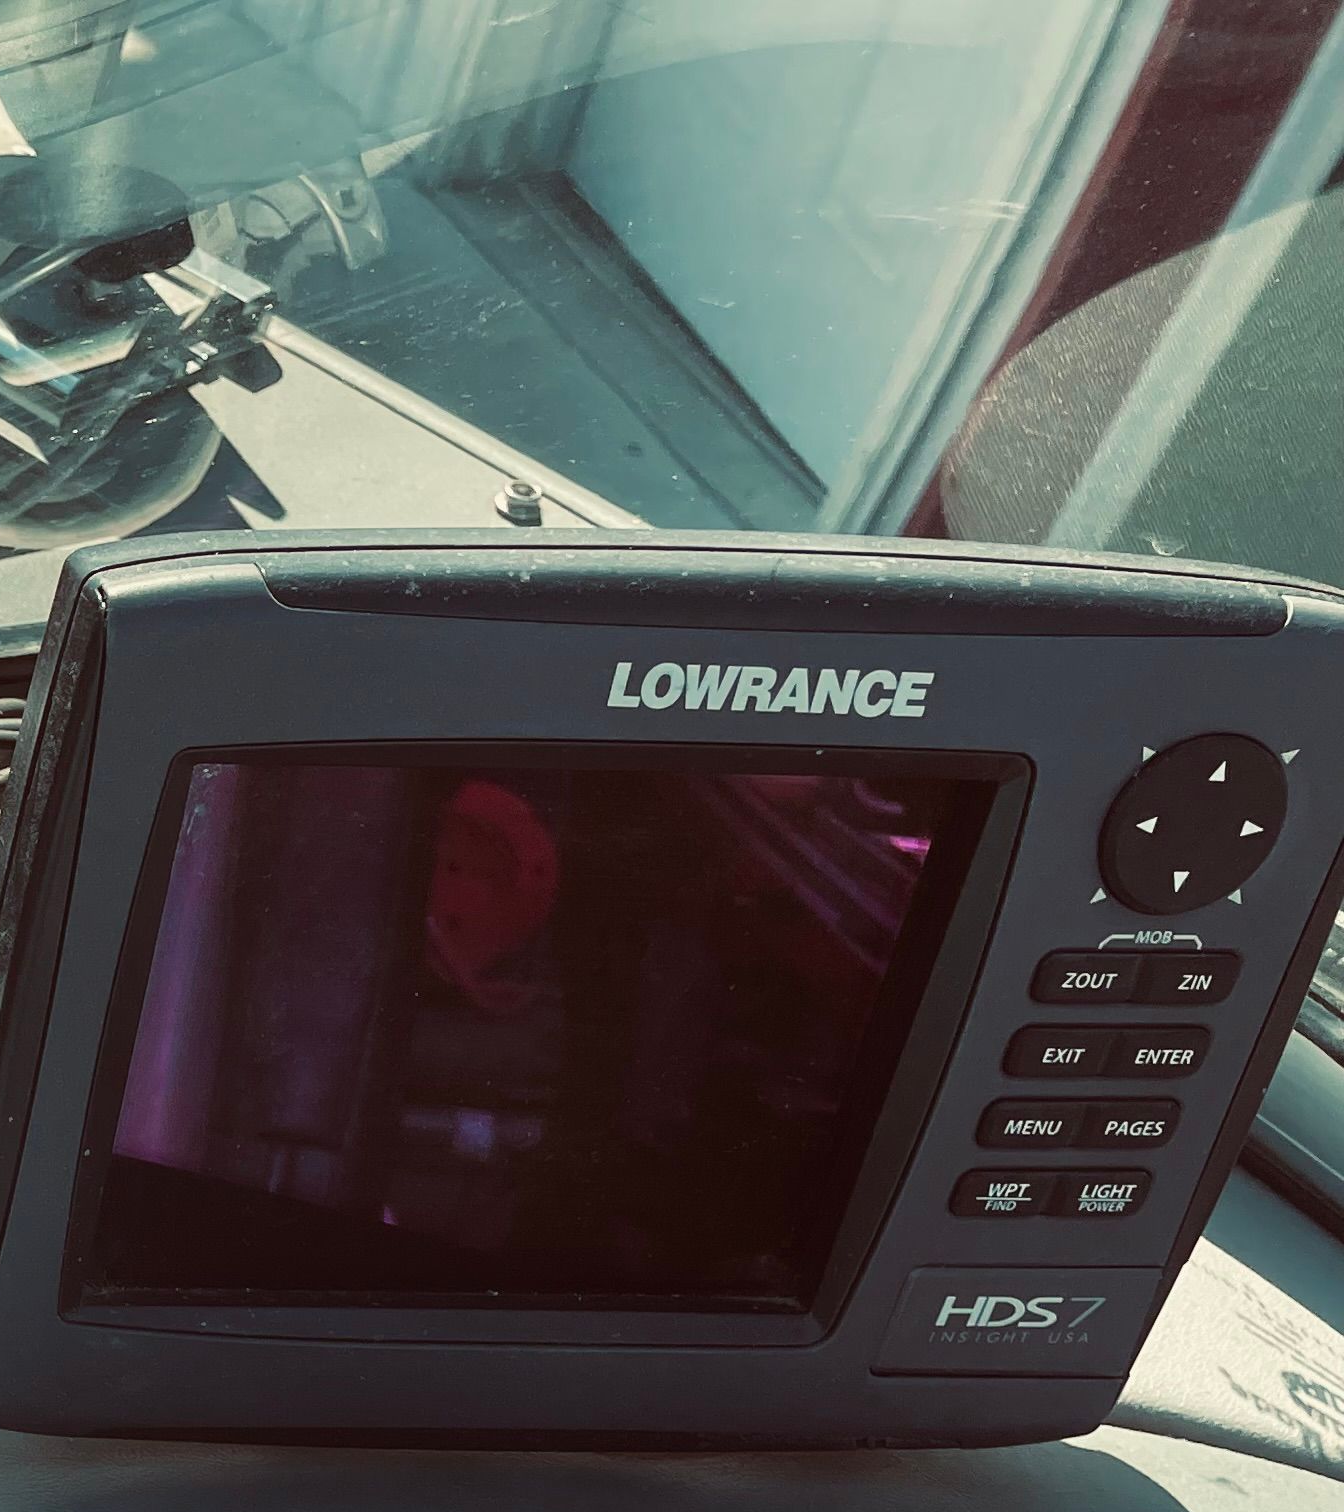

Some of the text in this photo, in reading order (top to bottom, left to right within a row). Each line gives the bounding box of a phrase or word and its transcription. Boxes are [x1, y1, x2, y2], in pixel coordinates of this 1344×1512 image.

[607, 662, 935, 717] LOWRANCE
[1134, 931, 1173, 944] MOB
[1061, 973, 1118, 989] ZOUT
[1178, 975, 1212, 990] ZIN
[1042, 1048, 1085, 1064] EXIT
[1134, 1050, 1194, 1065] ENTER
[1004, 1120, 1062, 1136] MENU
[1104, 1121, 1165, 1136] PAGES
[987, 1183, 1030, 1198] WPT
[1081, 1184, 1137, 1199] LIGHT
[984, 1201, 1016, 1212] FIND
[1078, 1201, 1125, 1213] POWER
[929, 1331, 1089, 1344] INSIGHT USA
